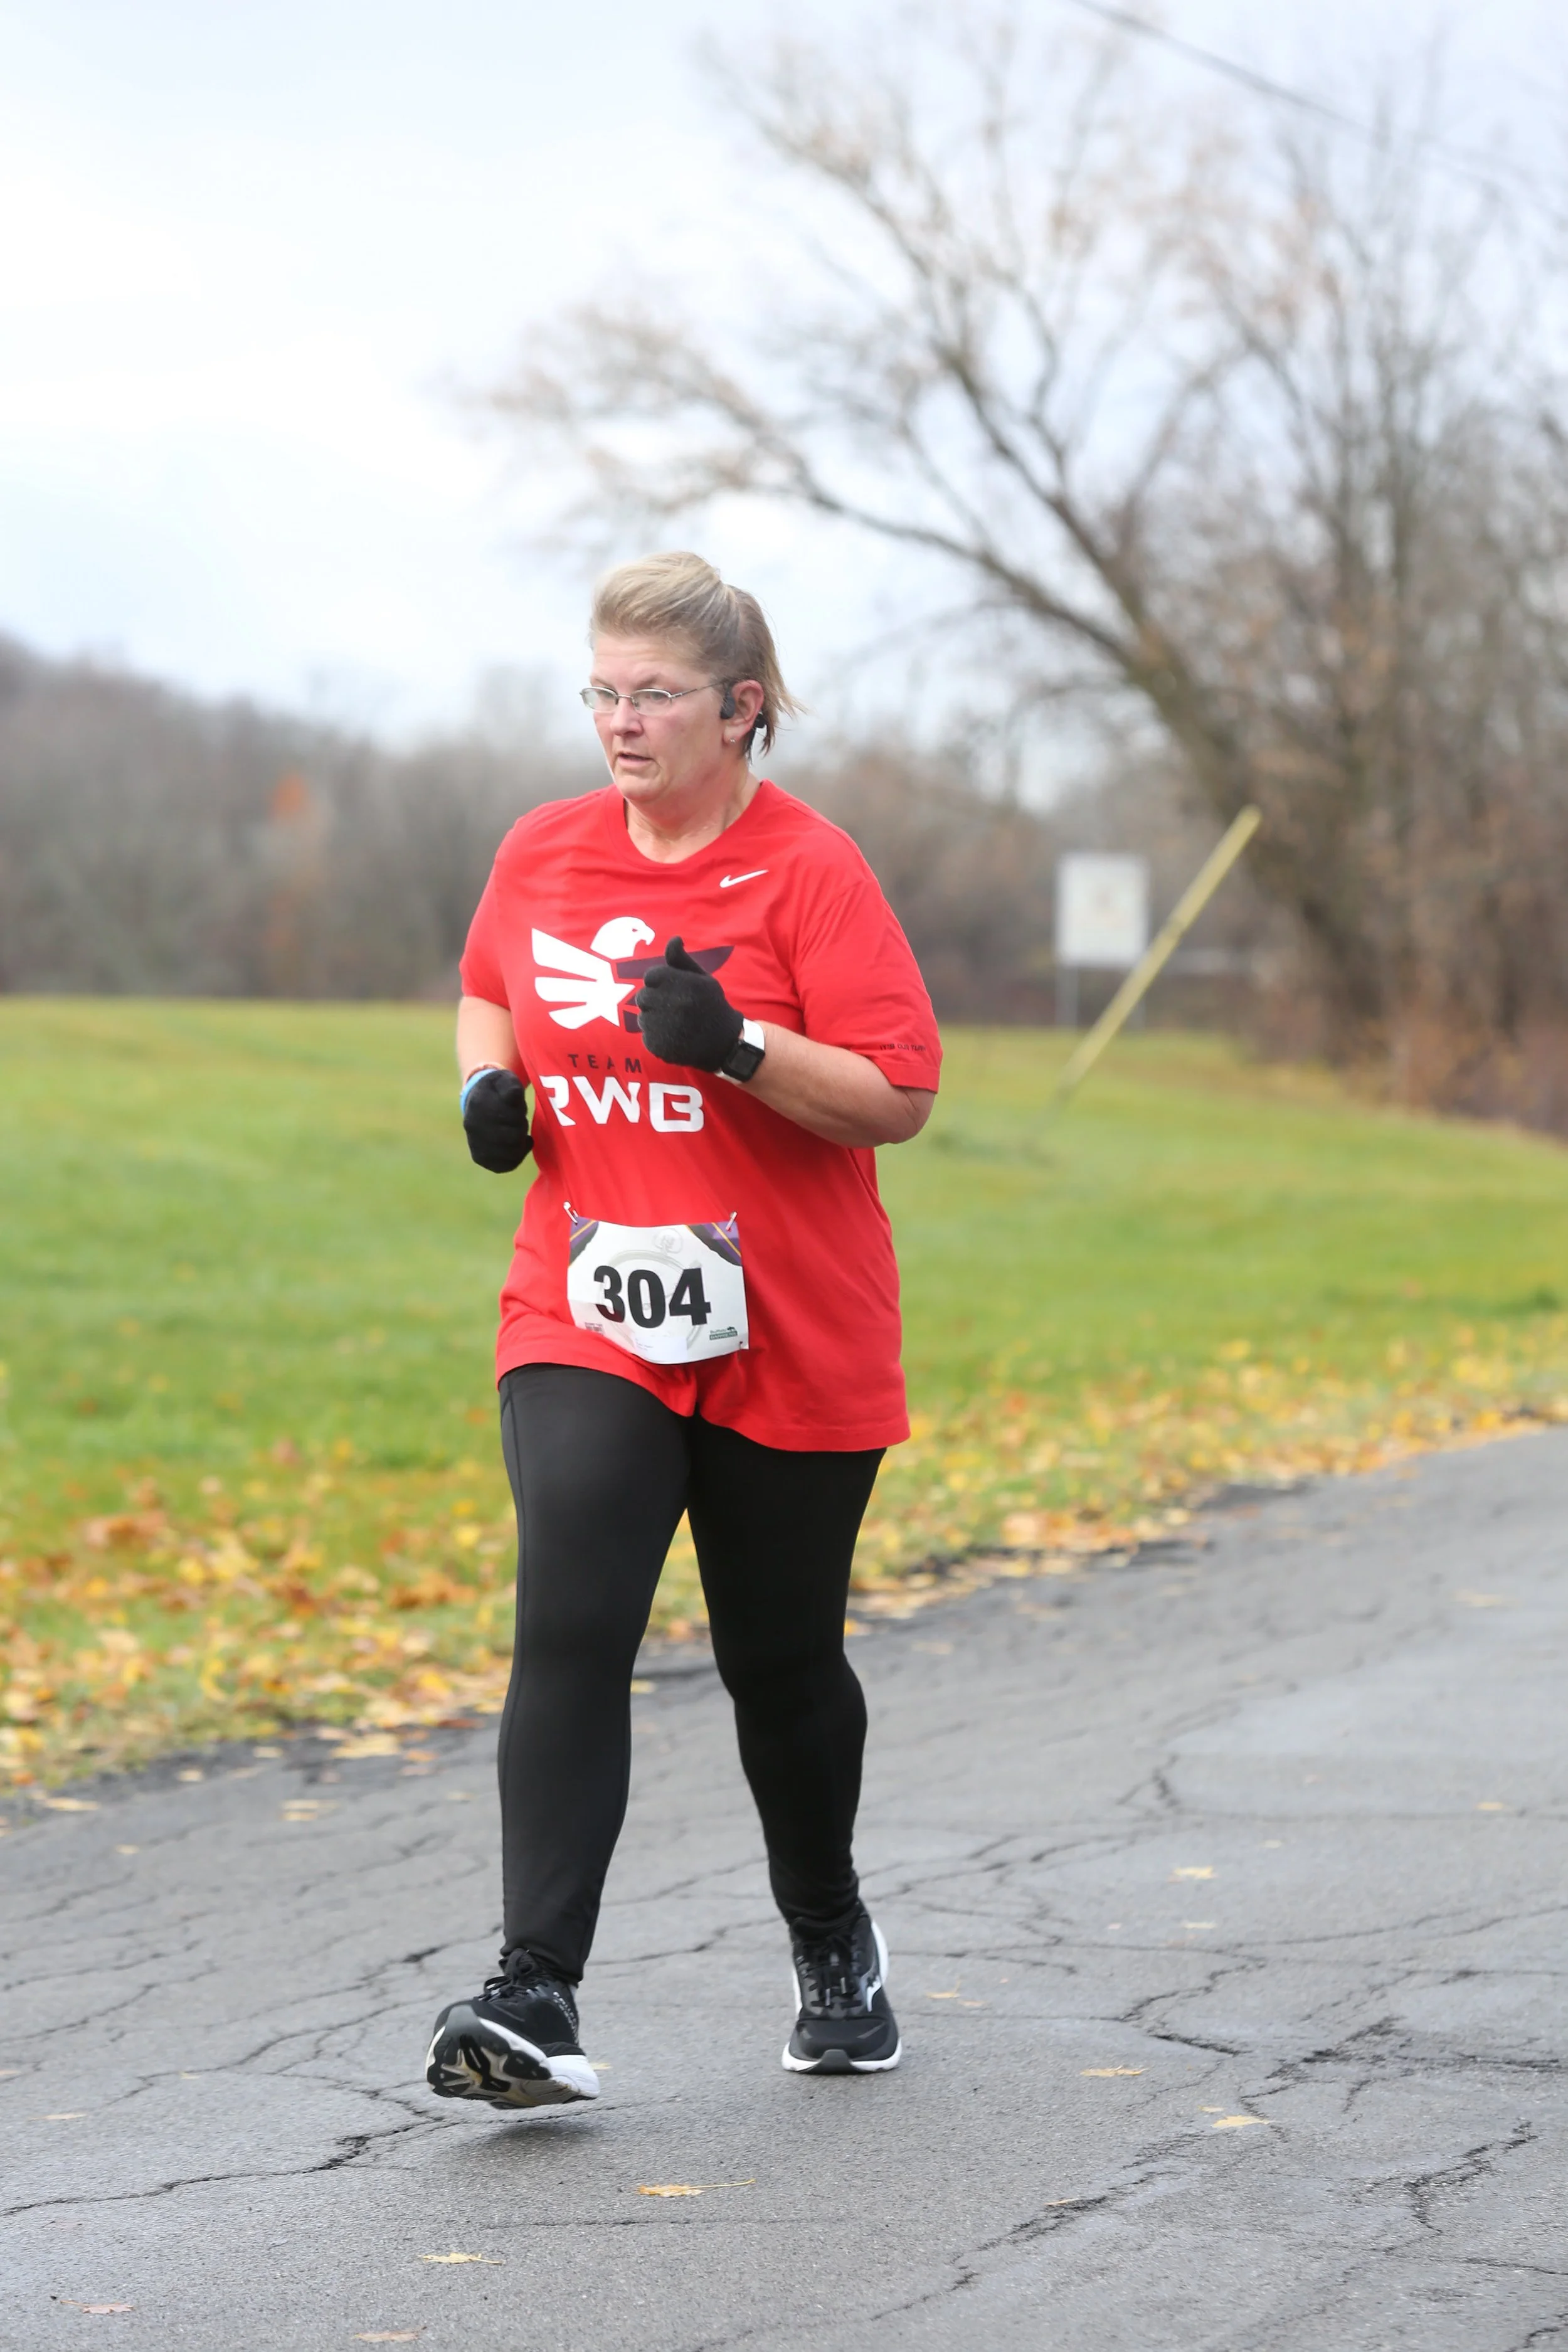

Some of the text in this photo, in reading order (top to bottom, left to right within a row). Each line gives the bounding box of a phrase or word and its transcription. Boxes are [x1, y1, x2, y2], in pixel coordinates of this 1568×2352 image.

[568, 1054, 642, 1073] TEAM
[539, 1075, 704, 1133] RWB
[593, 1265, 711, 1328] 304
